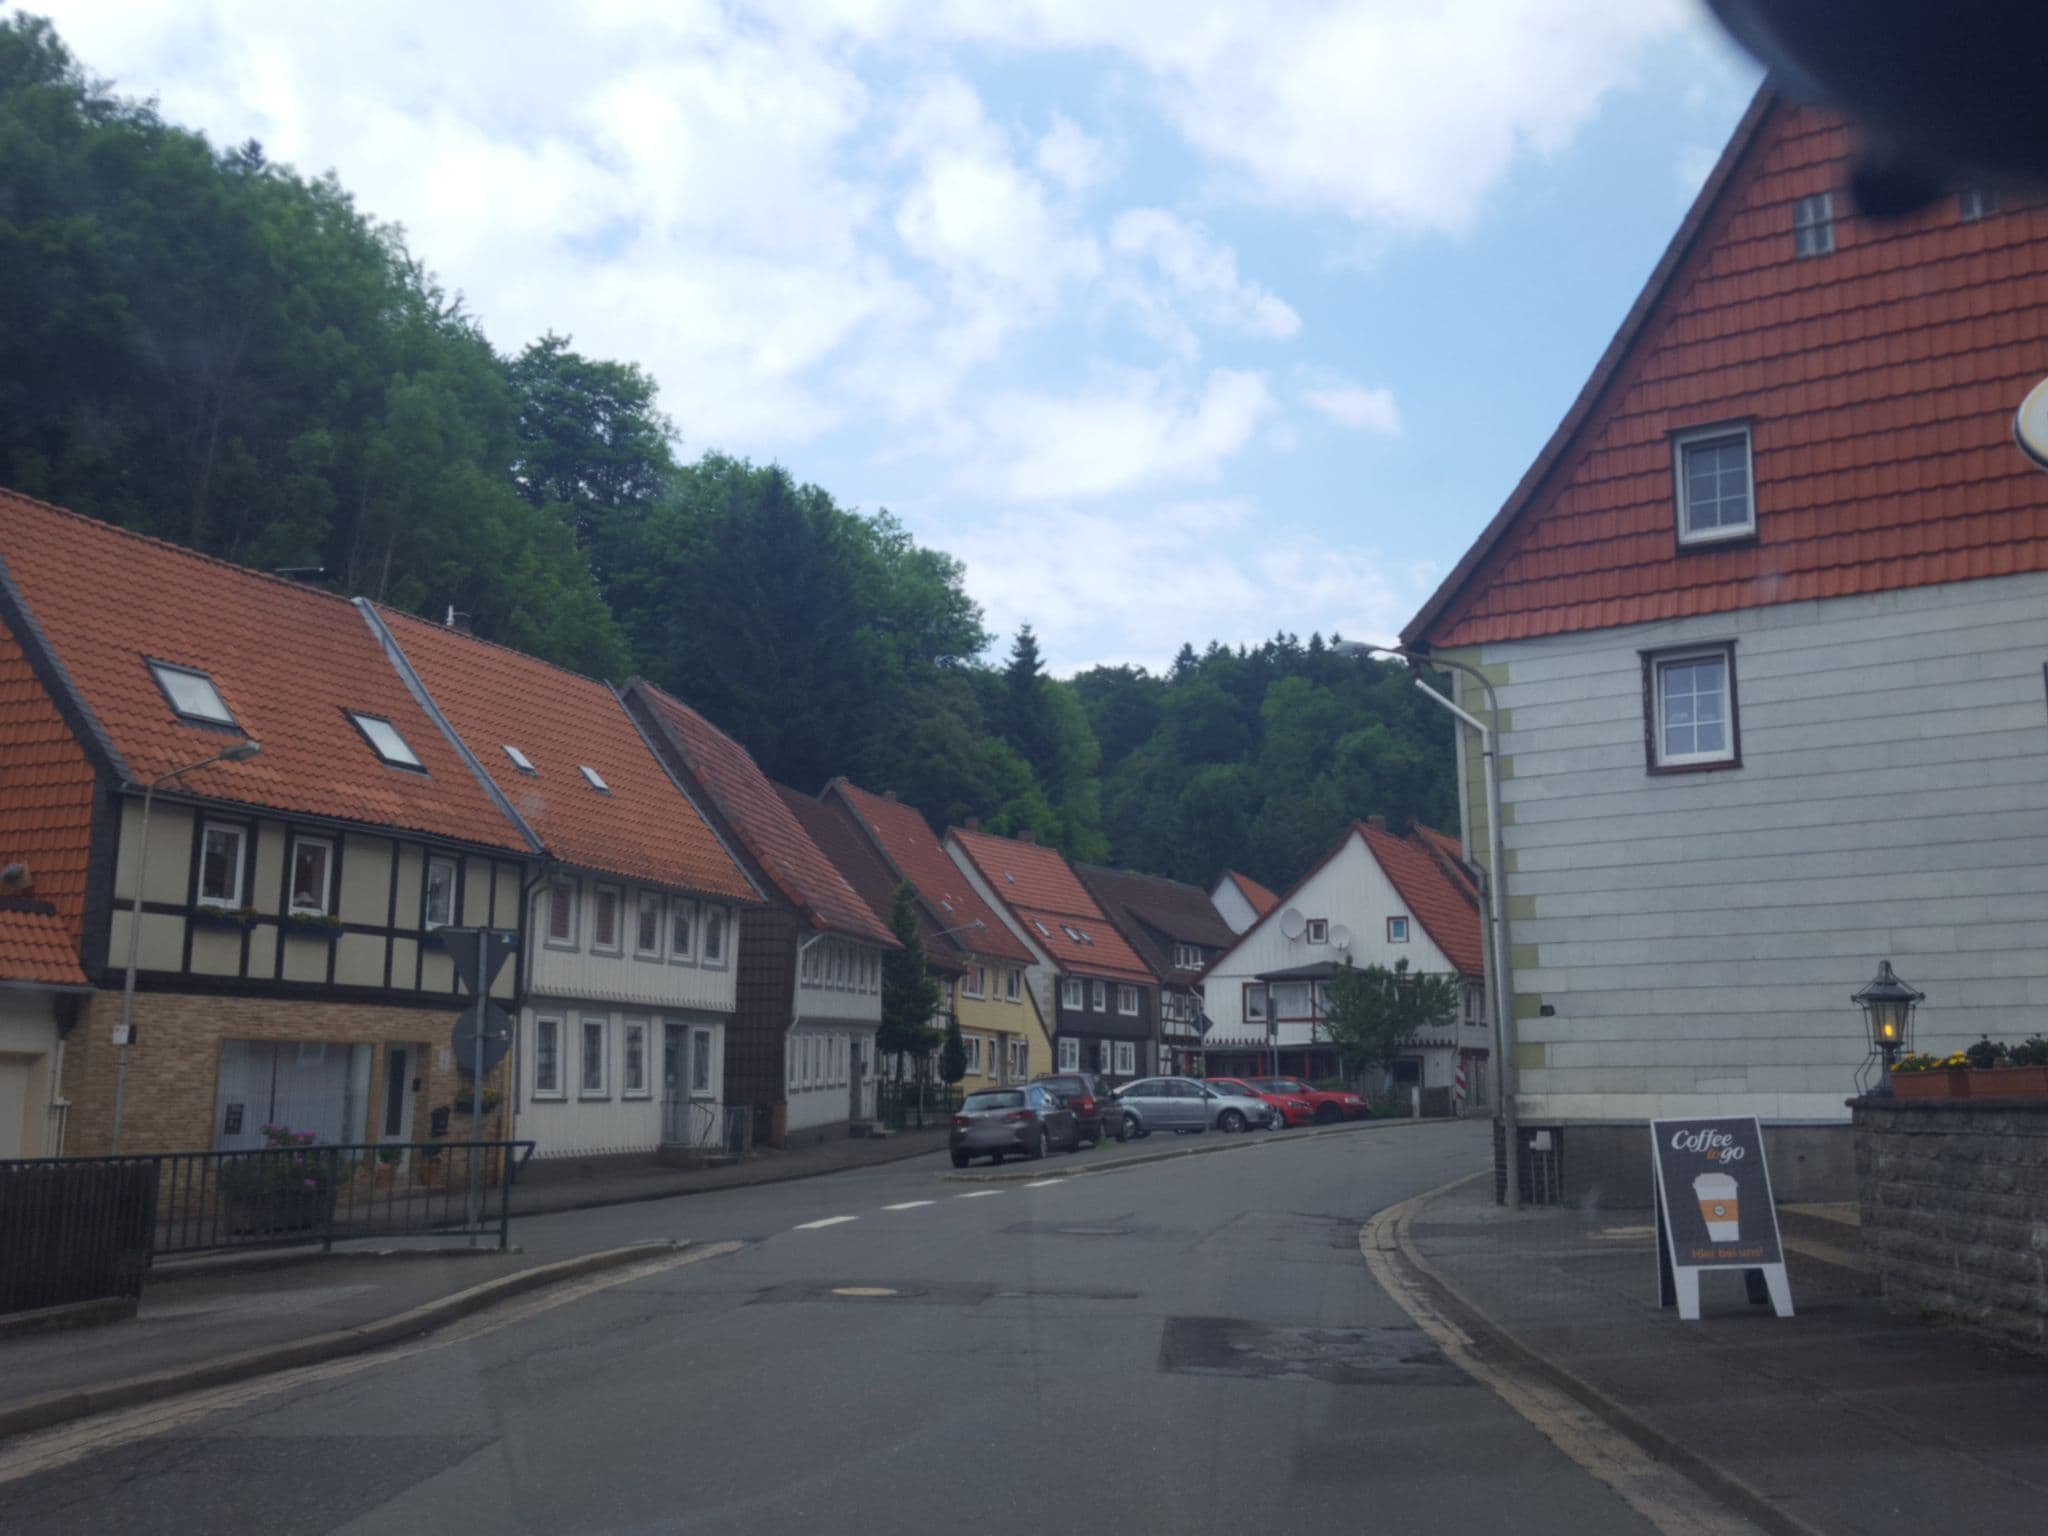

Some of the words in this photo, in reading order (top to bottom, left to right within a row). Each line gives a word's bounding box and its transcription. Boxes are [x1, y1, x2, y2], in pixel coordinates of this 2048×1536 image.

[1671, 1128, 1733, 1152] Coffee
[1707, 1148, 1720, 1160] to
[1720, 1146, 1745, 1164] go
